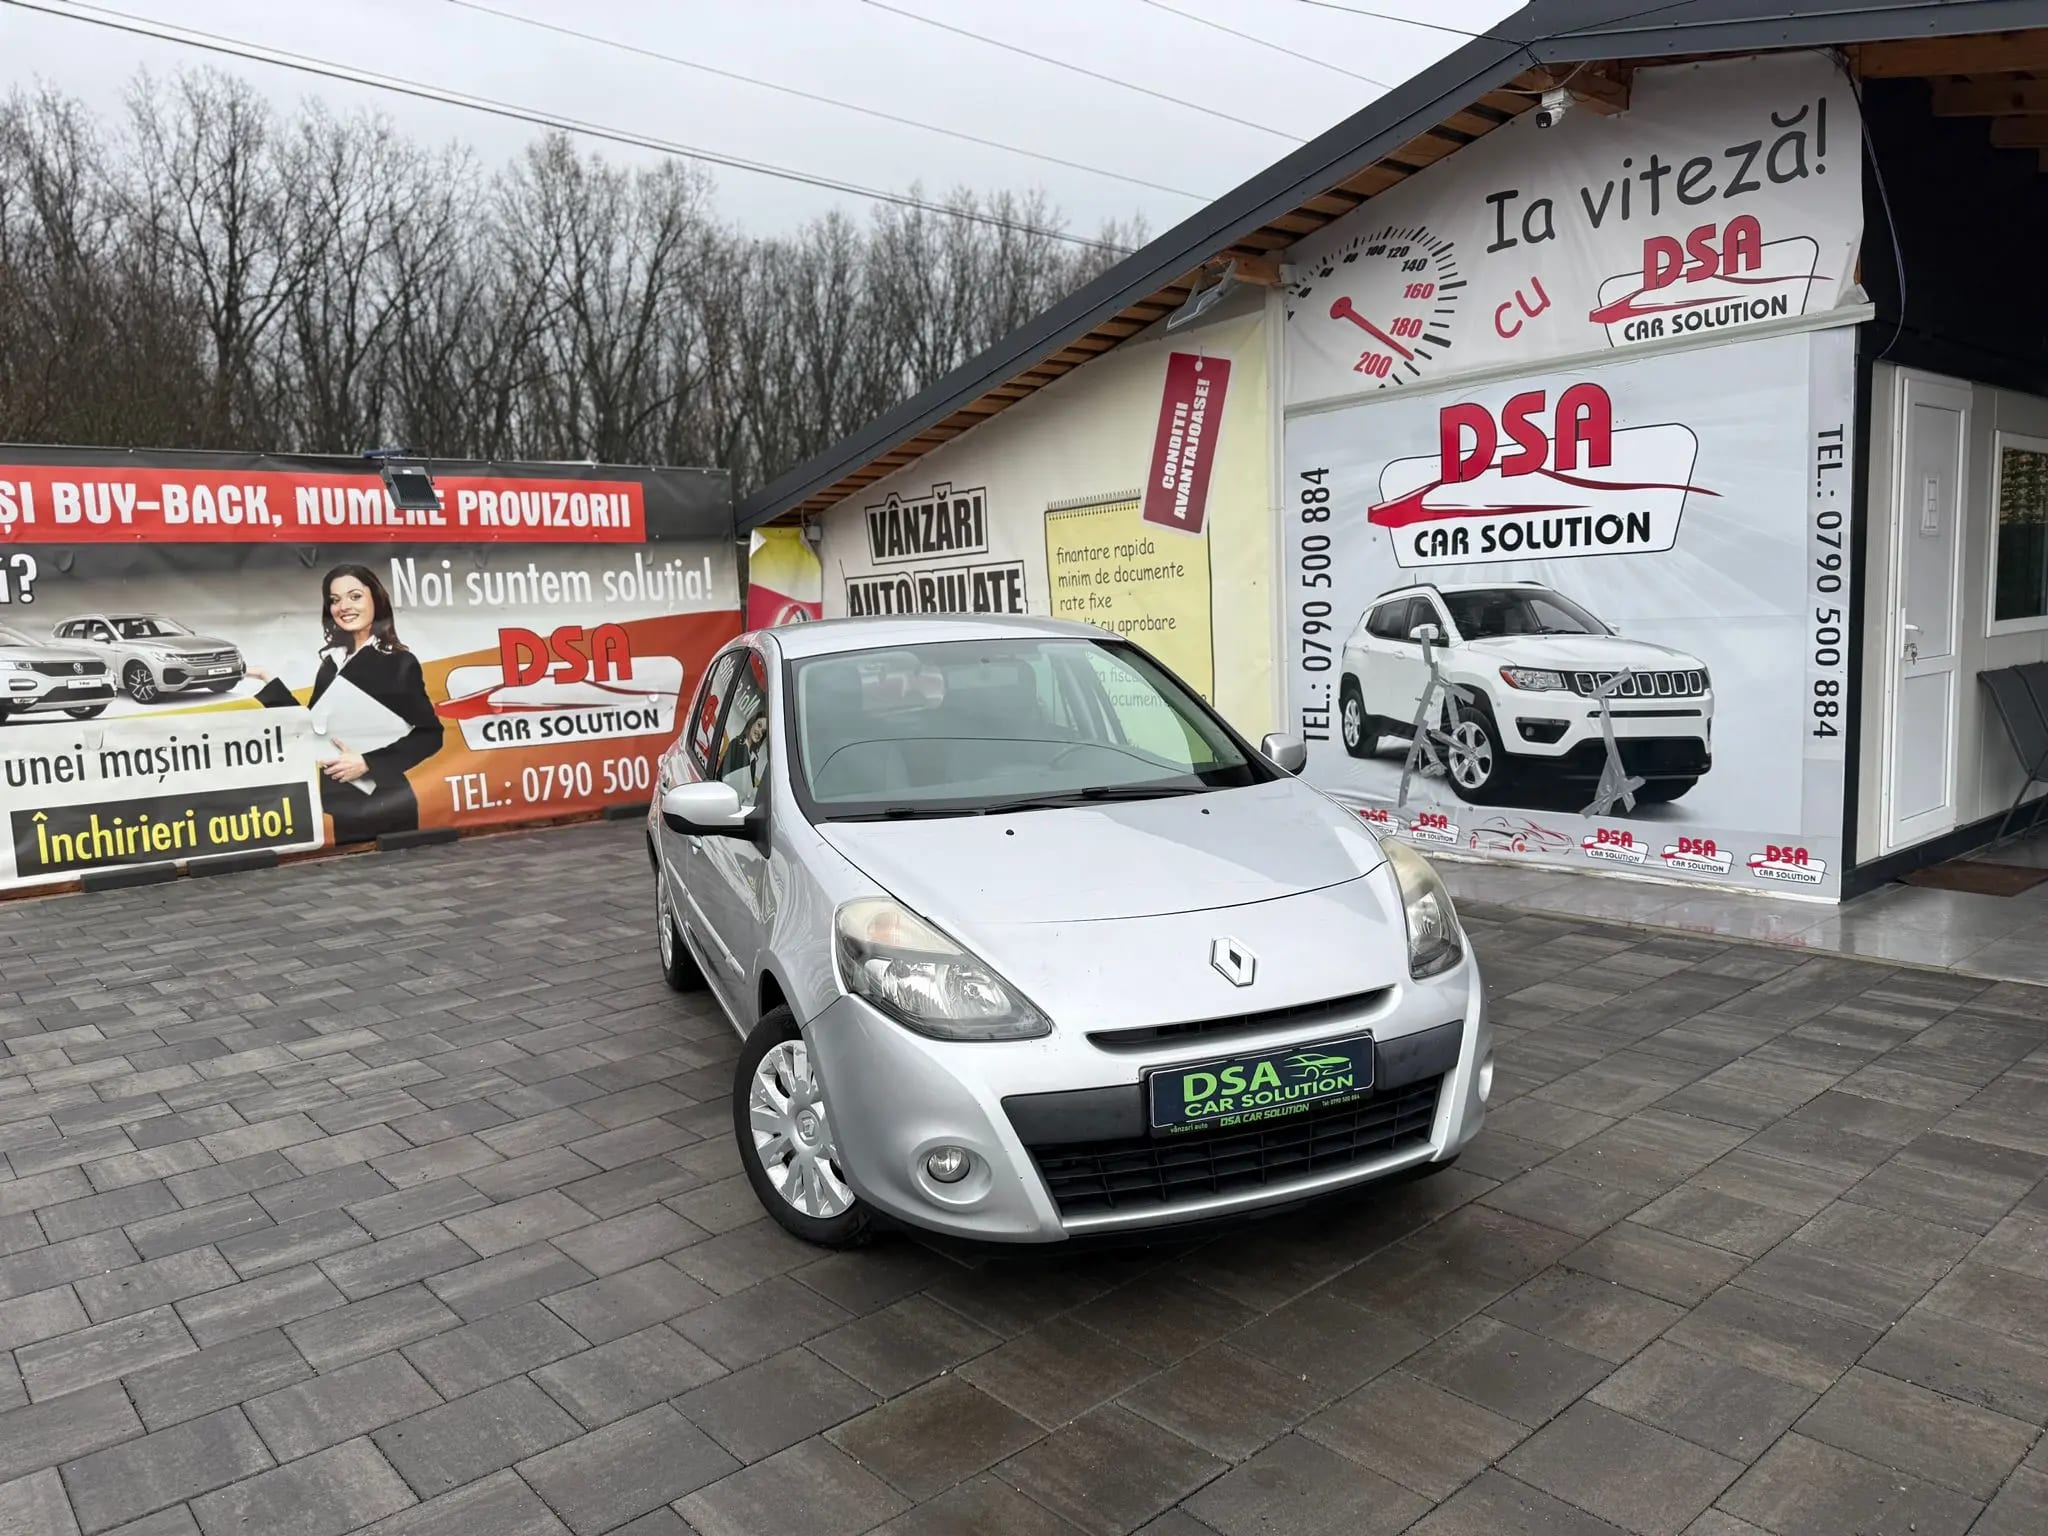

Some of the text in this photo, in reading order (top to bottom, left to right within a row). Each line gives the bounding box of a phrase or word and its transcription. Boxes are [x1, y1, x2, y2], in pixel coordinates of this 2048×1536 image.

[1486, 97, 1826, 253] Ia viteză!
[1387, 245, 1410, 259] 120
[1401, 258, 1428, 272] 140
[1643, 213, 1761, 290] DSA
[1403, 282, 1435, 299] 160
[1494, 276, 1551, 338] cu
[1389, 317, 1423, 338] 180
[1623, 294, 1787, 342] CAR SOLUTION
[1353, 351, 1393, 379] 200
[1162, 401, 1189, 489] CONDITII
[1173, 378, 1210, 520] AVANTAJOASE!
[1439, 382, 1612, 484] DSA
[457, 489, 631, 528] PROVIZORII
[1300, 466, 1330, 523] 884
[869, 490, 984, 558] VÂNZĂRI
[1414, 511, 1651, 558] CAR SOLUTION
[1056, 537, 1155, 565] finantare rapida
[1301, 534, 1331, 588] 500
[390, 551, 714, 612] Noi suntem soluția!
[1058, 561, 1184, 588] minim de documente
[1812, 423, 1844, 740] TEL.: 0790 500 884
[1060, 592, 1112, 611] rate fixe
[1118, 613, 1176, 636] aprobare
[1302, 600, 1333, 672] 0790
[498, 622, 633, 688] DSA
[482, 708, 660, 743] CAR SOLUTION
[5, 725, 285, 787] unei mașini noi!
[445, 772, 512, 813] TEL.:
[522, 760, 593, 803] 0790
[602, 754, 650, 795] 500
[32, 796, 294, 865] Închirieri auto!
[1418, 812, 1449, 829] DSA
[1428, 833, 1455, 843] SOLUTION
[1597, 828, 1633, 847] DSA
[1590, 849, 1640, 863] CAR SOLUTION
[1671, 859, 1724, 873] CAR SOLUTION
[1678, 837, 1717, 857] DSA
[1766, 844, 1809, 866] DSA
[1758, 868, 1816, 882] CAR SOLUTION
[1183, 1060, 1282, 1102] DSA
[1184, 1074, 1354, 1117] CAR SOLUTION
[1220, 1116, 1242, 1127] DSA
[1243, 1111, 1263, 1123] CAR
[1264, 1102, 1310, 1118] SOLUTION
